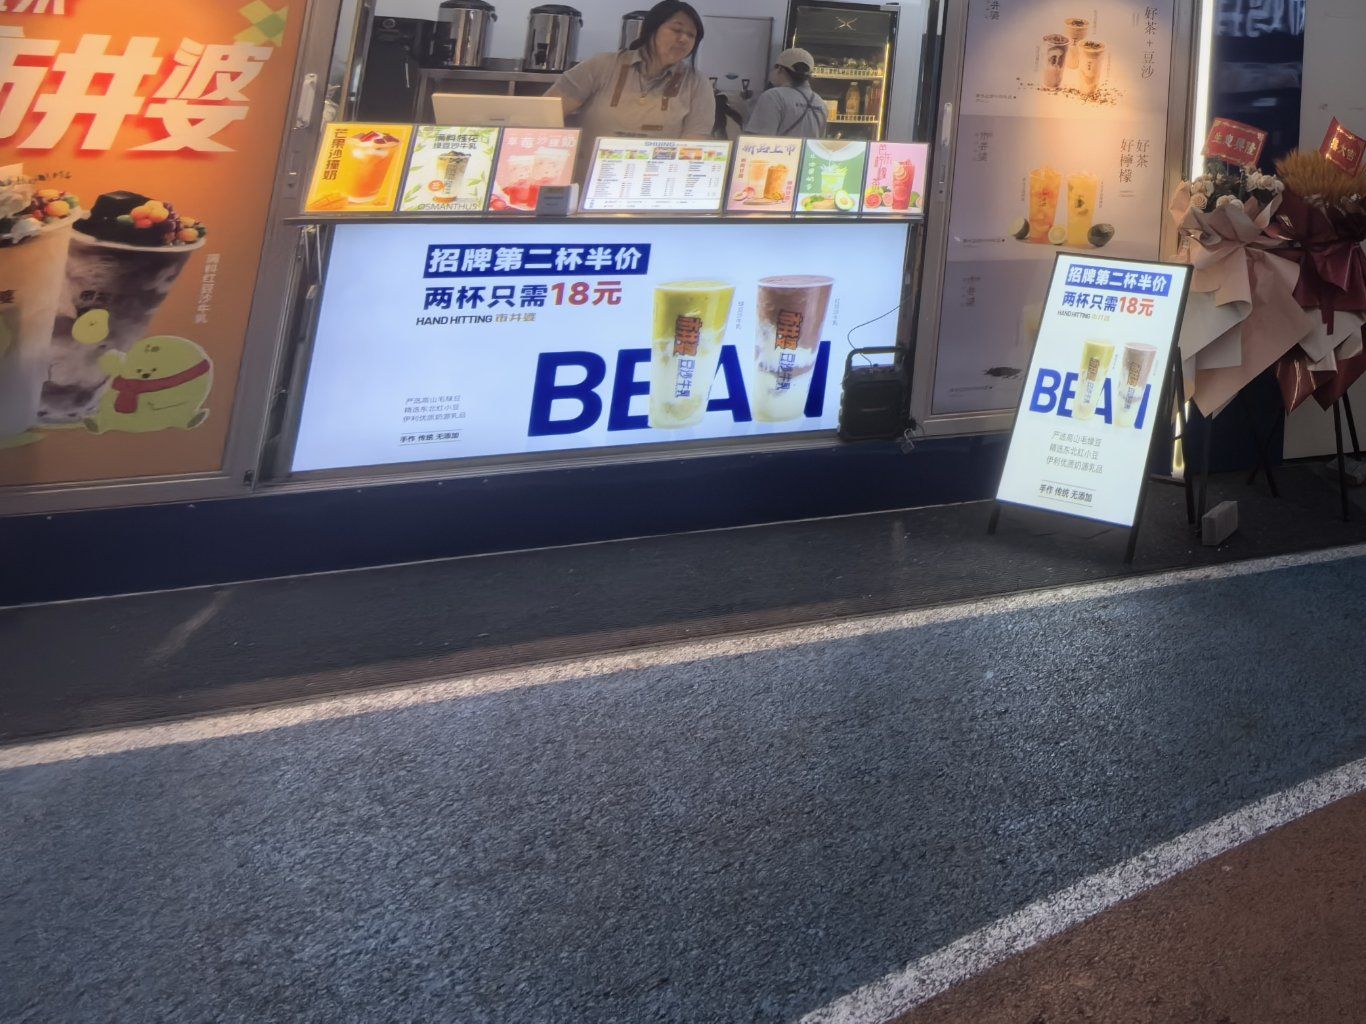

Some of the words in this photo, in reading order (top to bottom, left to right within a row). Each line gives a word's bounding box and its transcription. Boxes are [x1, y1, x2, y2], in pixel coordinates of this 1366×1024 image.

[322, 128, 349, 182] 芒果沙撞奶
[1136, 138, 1150, 169] 好茶
[428, 246, 643, 273] 招牌第二杯半价
[1066, 266, 1168, 293] 招牌第二杯半价
[423, 280, 623, 311] 两杯只需18元
[1061, 291, 1154, 317] 两杯只需18元
[416, 316, 448, 326] HAND
[449, 314, 493, 325] HITTING
